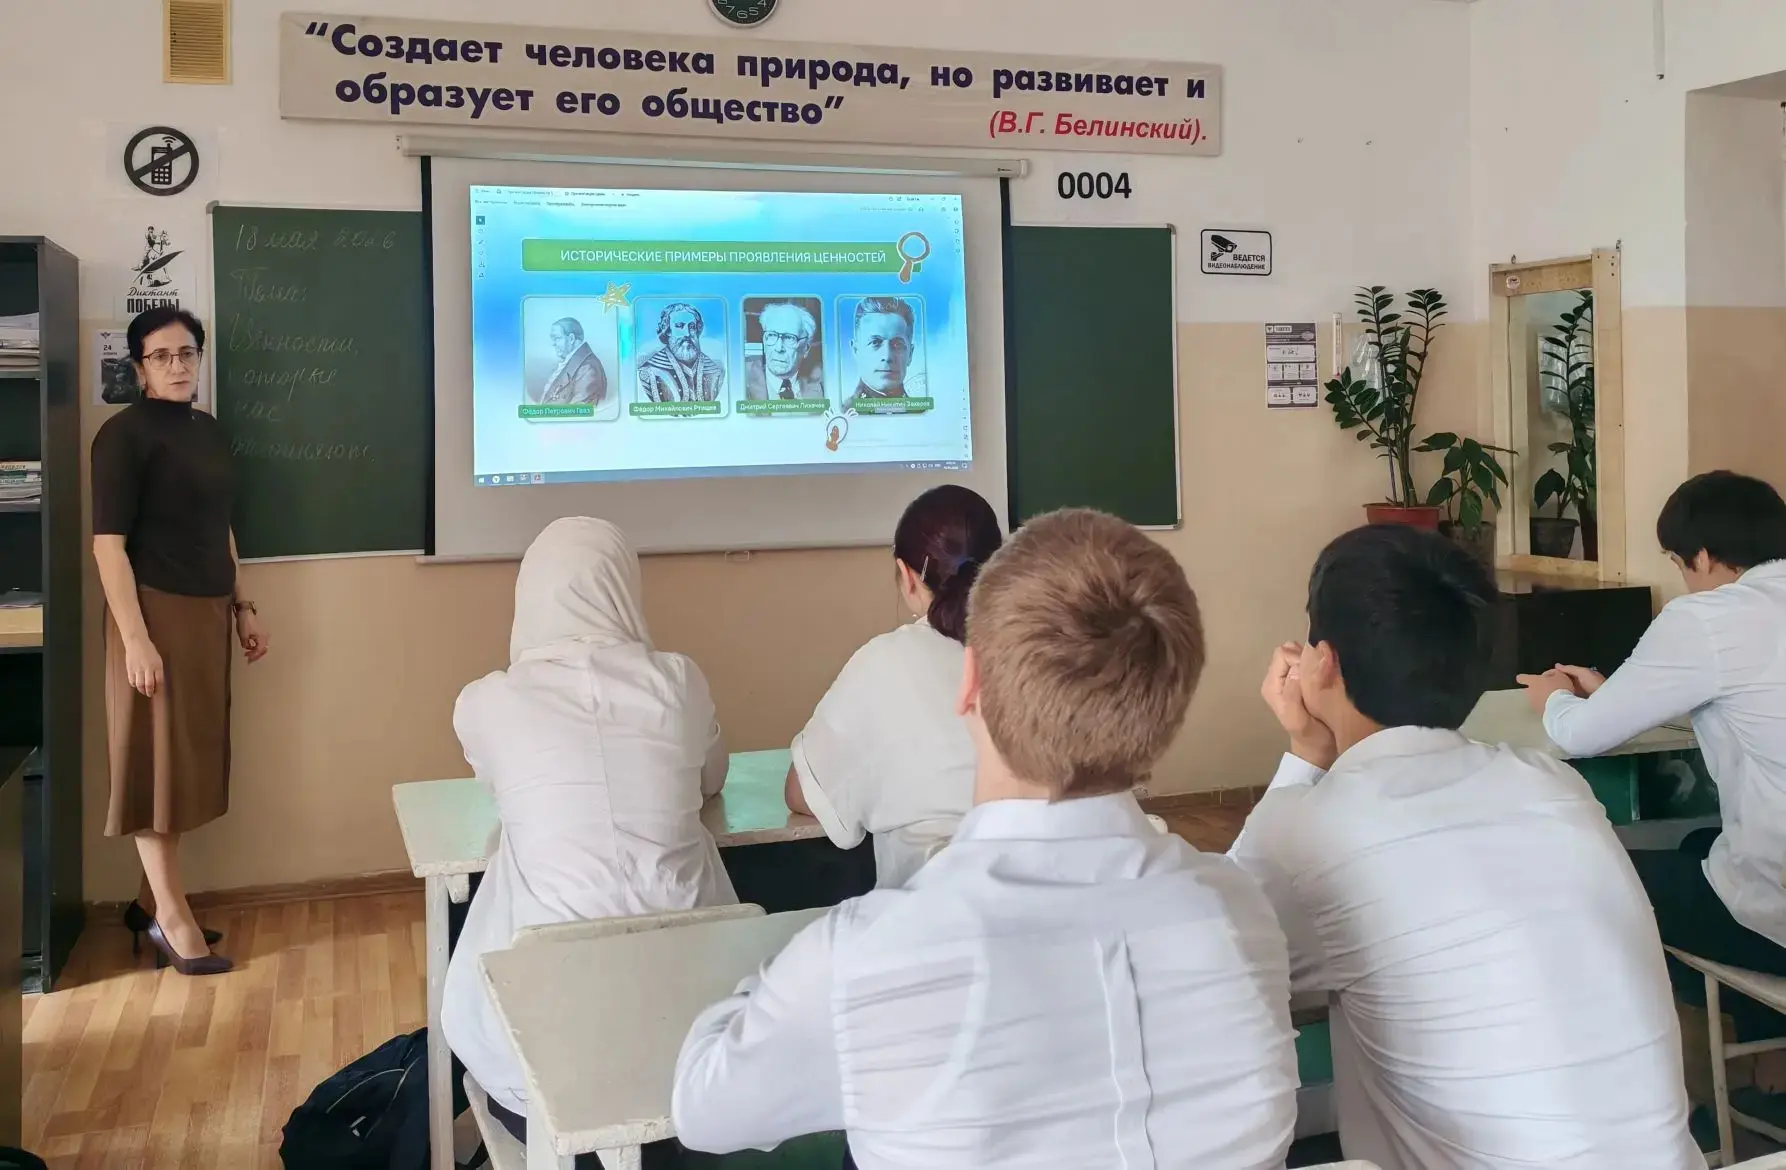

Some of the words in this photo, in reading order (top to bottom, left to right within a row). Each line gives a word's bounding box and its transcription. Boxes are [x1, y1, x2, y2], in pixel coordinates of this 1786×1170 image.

[726, 5, 735, 14] 7
[737, 10, 748, 19] 6
[525, 41, 715, 75] человека
[737, 54, 910, 90] природа,
[930, 65, 973, 88] но
[993, 68, 1169, 99] развивает
[1186, 77, 1205, 98] и
[335, 72, 534, 119] образует
[556, 90, 620, 116] его
[989, 111, 1046, 139] (В.Г.
[1054, 113, 1208, 146] Белинский).
[1057, 171, 1132, 199] 0004
[560, 250, 662, 262] ИСТОРИЧЕСКИЕ
[665, 251, 726, 263] ПРИМЕРЫ
[729, 251, 811, 263] ПРОЯВЛЕНИЯ
[814, 250, 886, 264] ЦЕННОСТЕЙ
[1232, 253, 1266, 262] ВЕДЕТСЯ
[1207, 262, 1266, 270] ВИДЕОНАБЛЮДЕНИЕ
[127, 286, 179, 297] Диктант
